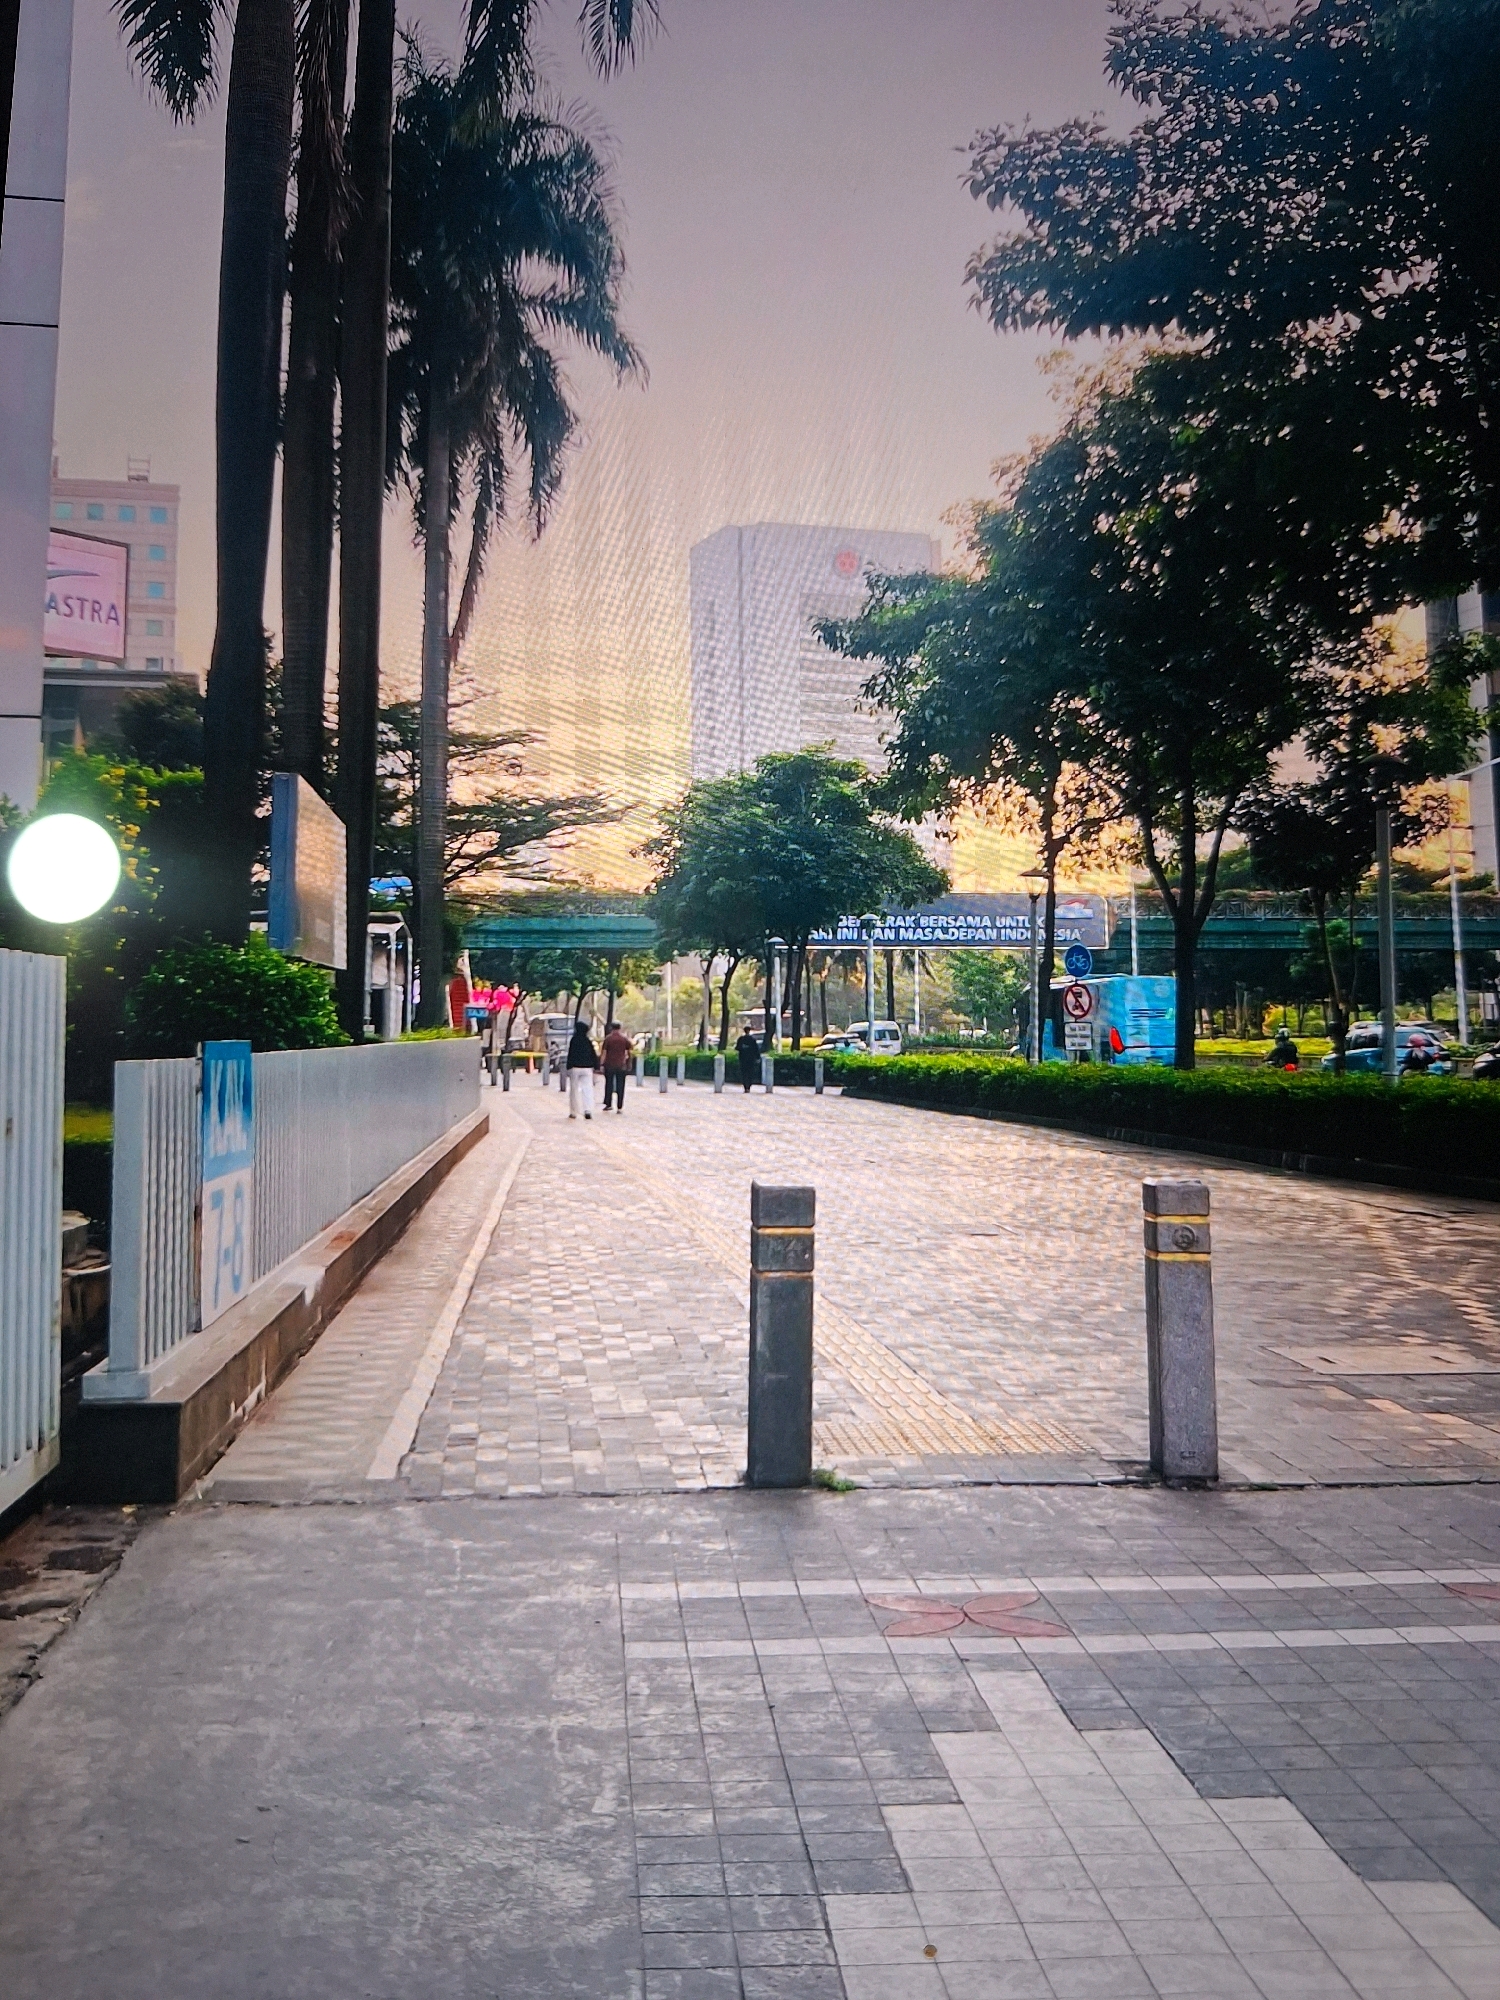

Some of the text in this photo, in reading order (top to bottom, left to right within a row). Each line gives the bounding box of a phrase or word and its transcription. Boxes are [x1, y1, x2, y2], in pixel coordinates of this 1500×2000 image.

[45, 591, 120, 627] ASTRA
[836, 927, 859, 941] INI
[899, 927, 947, 941] MASA
[948, 927, 998, 941] DEPAN
[920, 915, 992, 928] BERSAMA
[211, 1181, 244, 1310] 7-8
